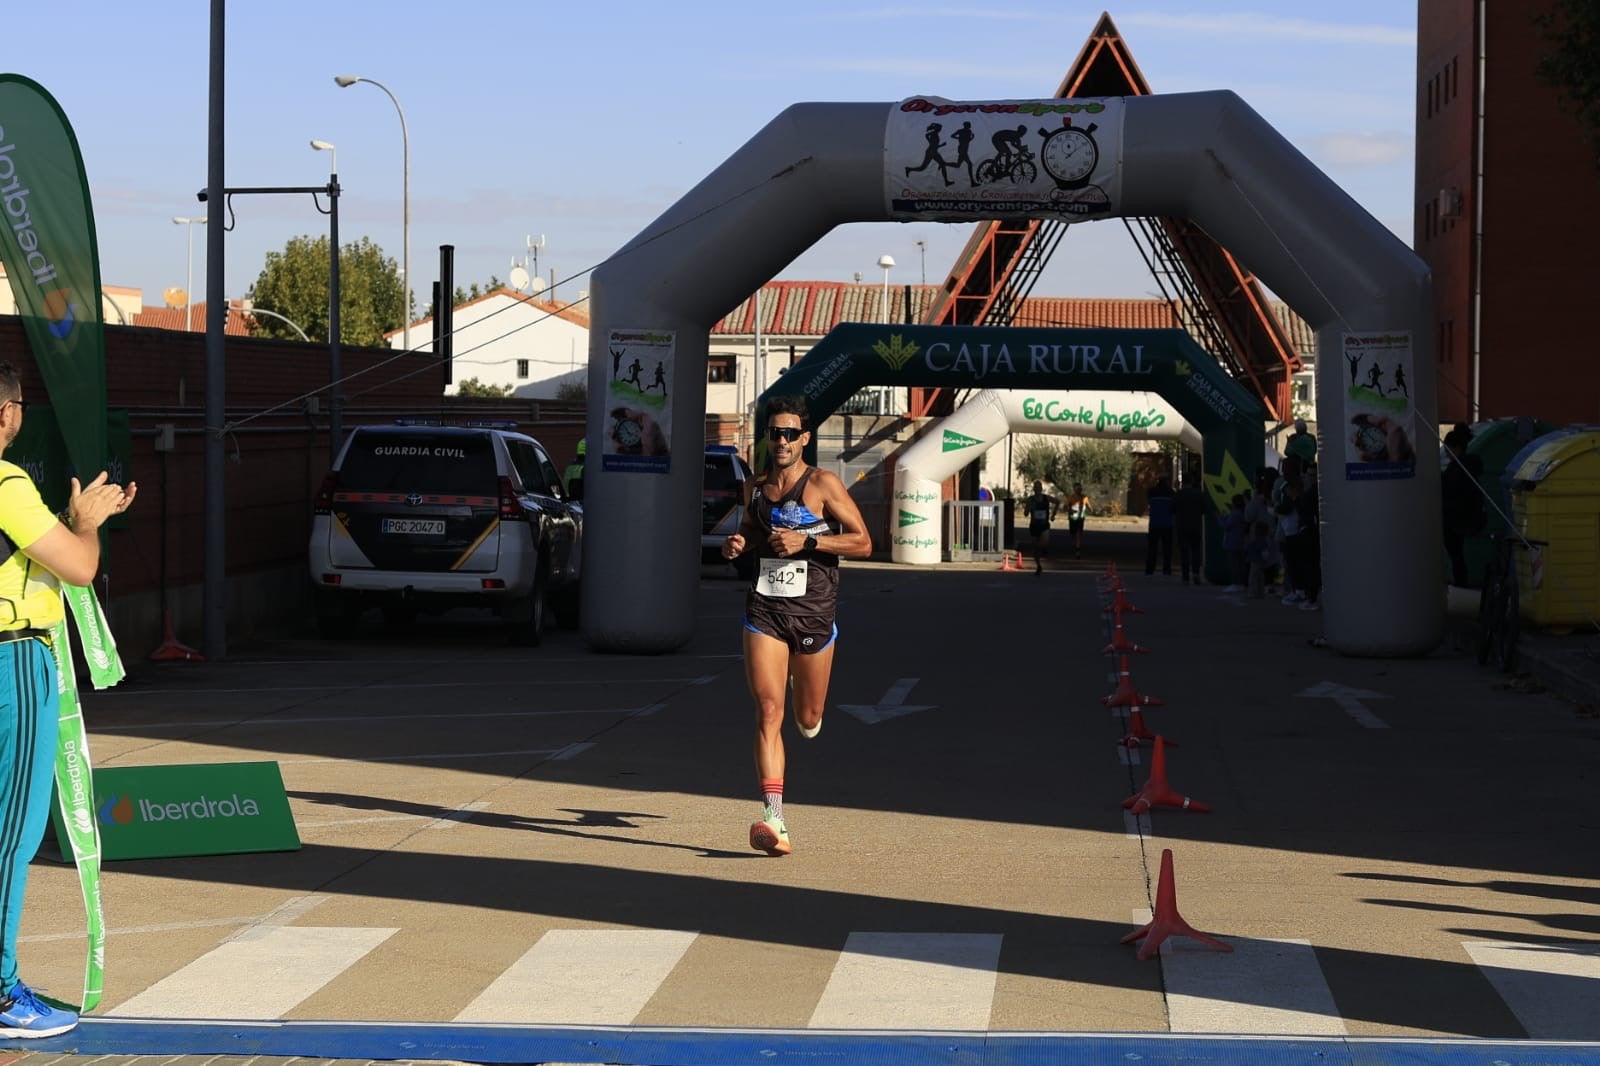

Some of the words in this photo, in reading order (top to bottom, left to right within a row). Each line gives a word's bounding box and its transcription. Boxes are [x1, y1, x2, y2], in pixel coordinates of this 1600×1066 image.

[924, 341, 1016, 380] CAJA
[1027, 343, 1153, 375] RURAL
[1023, 398, 1043, 421] El
[1045, 401, 1094, 425] Corte
[1096, 400, 1167, 434] Inglés
[374, 446, 431, 456] GUARDIA
[434, 447, 465, 458] CIVIL
[389, 520, 407, 531] PGC
[409, 521, 434, 533] 2047
[767, 570, 795, 585] 542
[64, 739, 86, 806] Iberdrola
[138, 793, 260, 822] Iberdrola
